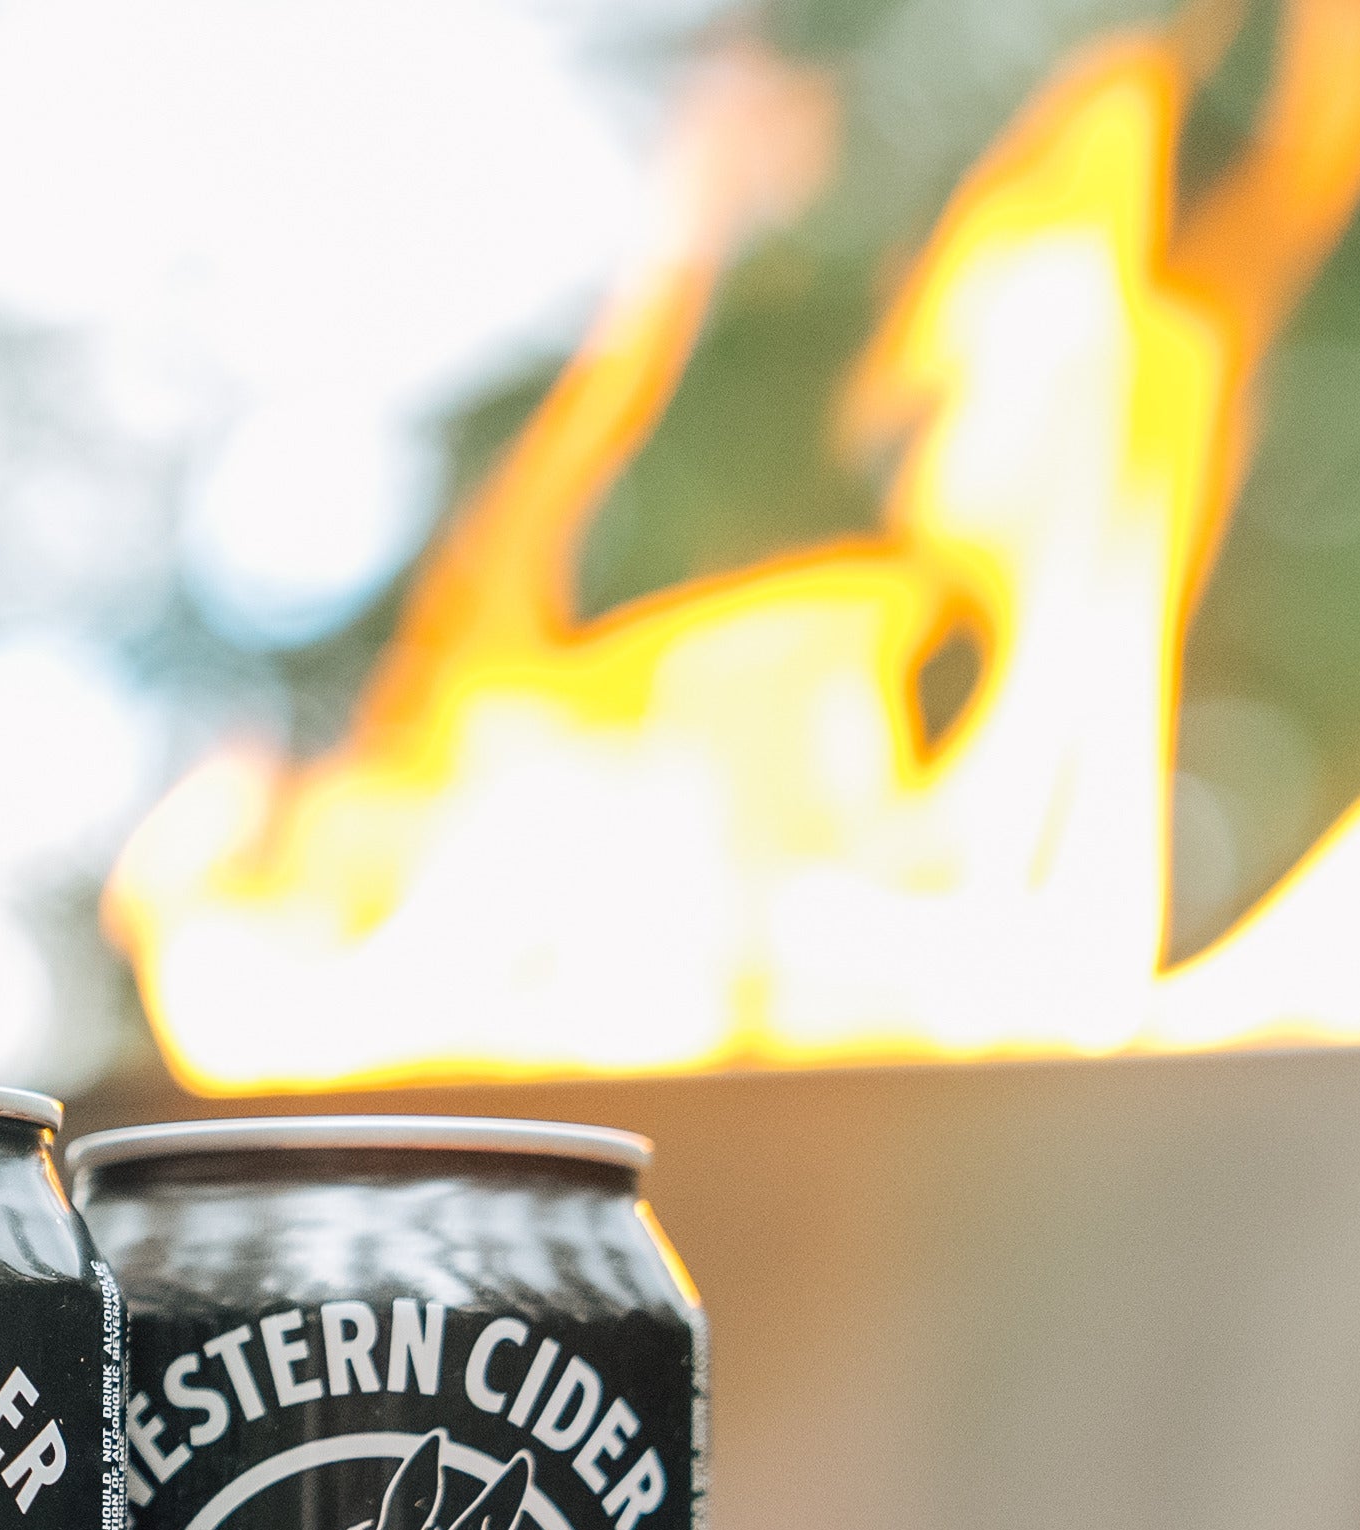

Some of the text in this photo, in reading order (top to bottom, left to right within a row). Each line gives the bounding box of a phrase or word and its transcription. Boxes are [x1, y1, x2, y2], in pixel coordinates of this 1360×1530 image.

[90, 1260, 112, 1355] ALCOHOLIC
[103, 1365, 112, 1419] DRINK
[112, 1365, 120, 1462] ALCOHOLIC
[103, 1428, 112, 1462] NOT
[111, 1467, 119, 1489] OF
